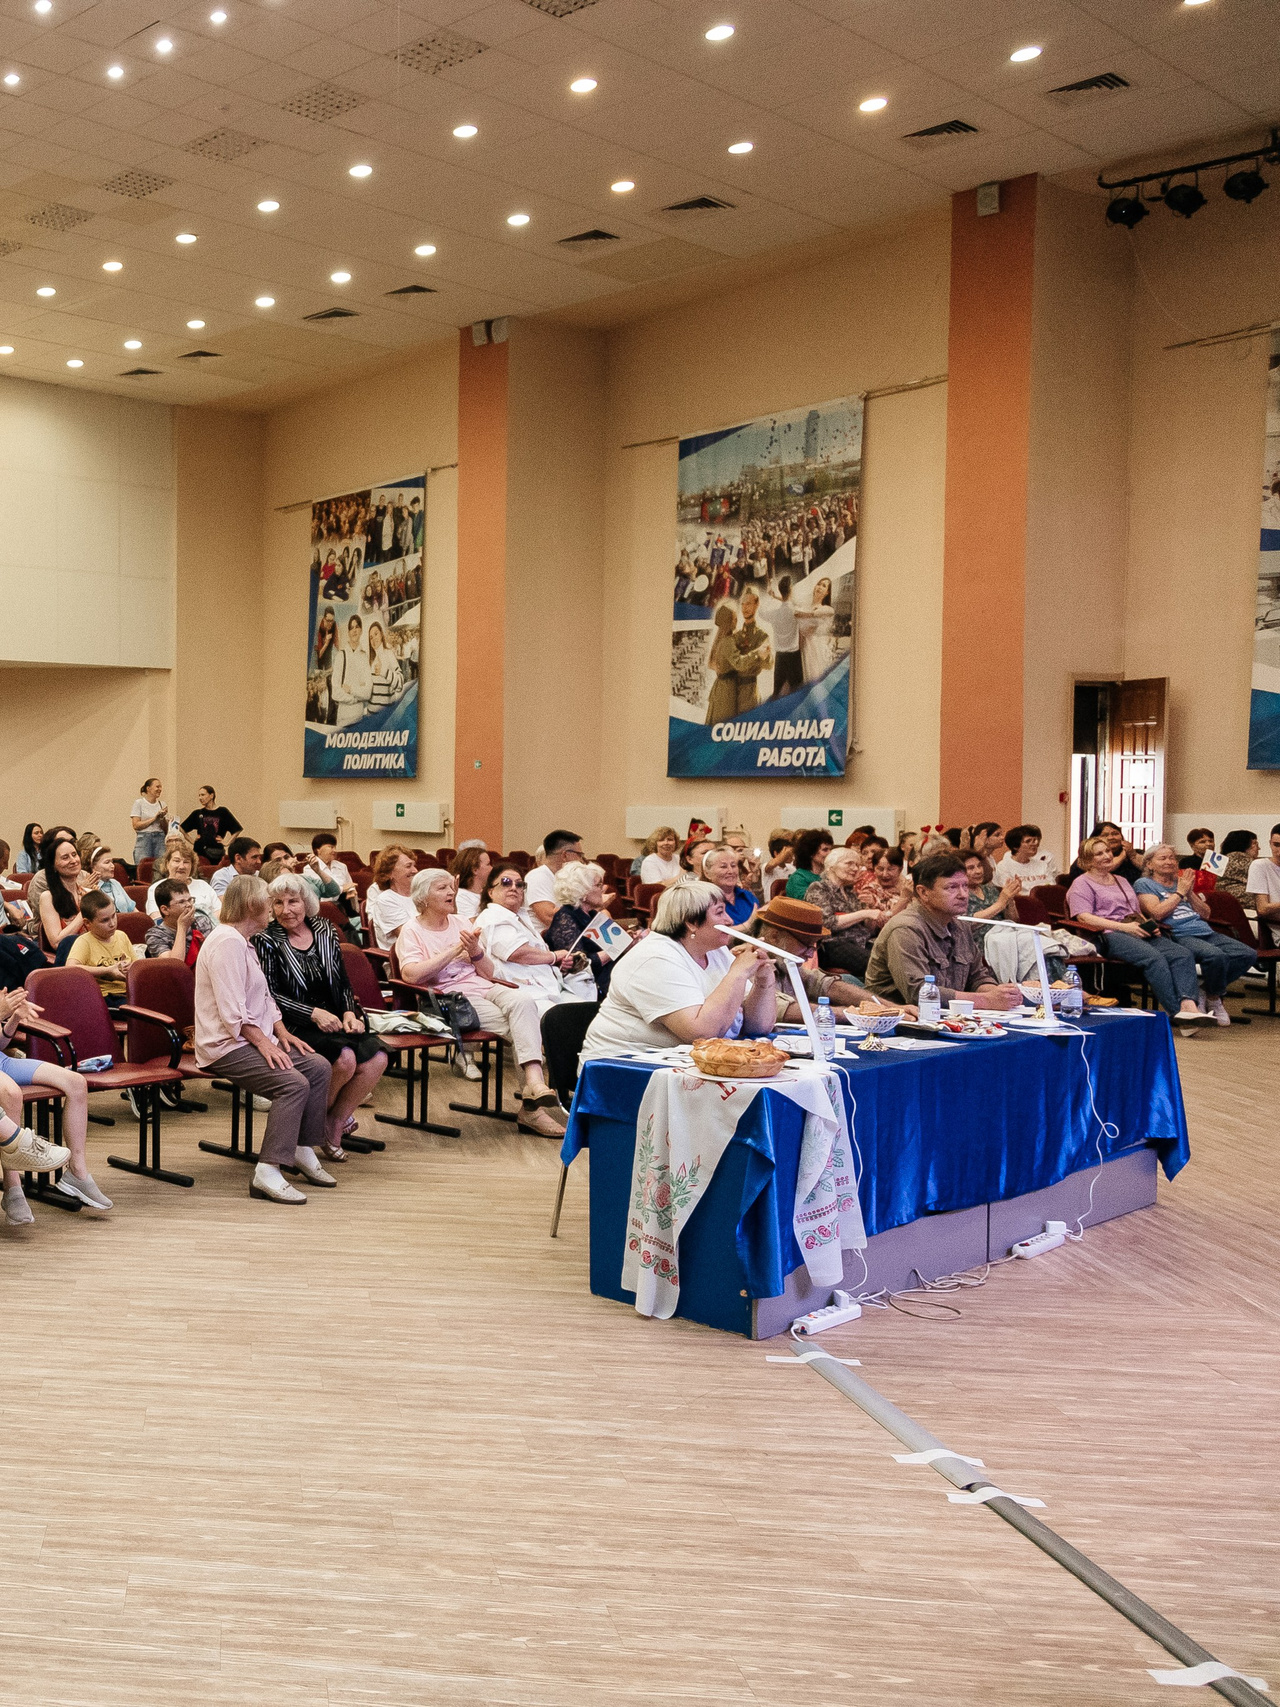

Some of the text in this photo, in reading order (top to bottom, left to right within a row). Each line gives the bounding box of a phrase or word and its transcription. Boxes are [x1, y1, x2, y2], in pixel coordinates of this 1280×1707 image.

[325, 729, 410, 750] МОЛОДЕЖНАЯ
[711, 718, 835, 743] СОЦИАЛЬНАЯ
[343, 753, 405, 770] ПОЛИТИКА
[756, 746, 827, 768] РАБОТА
